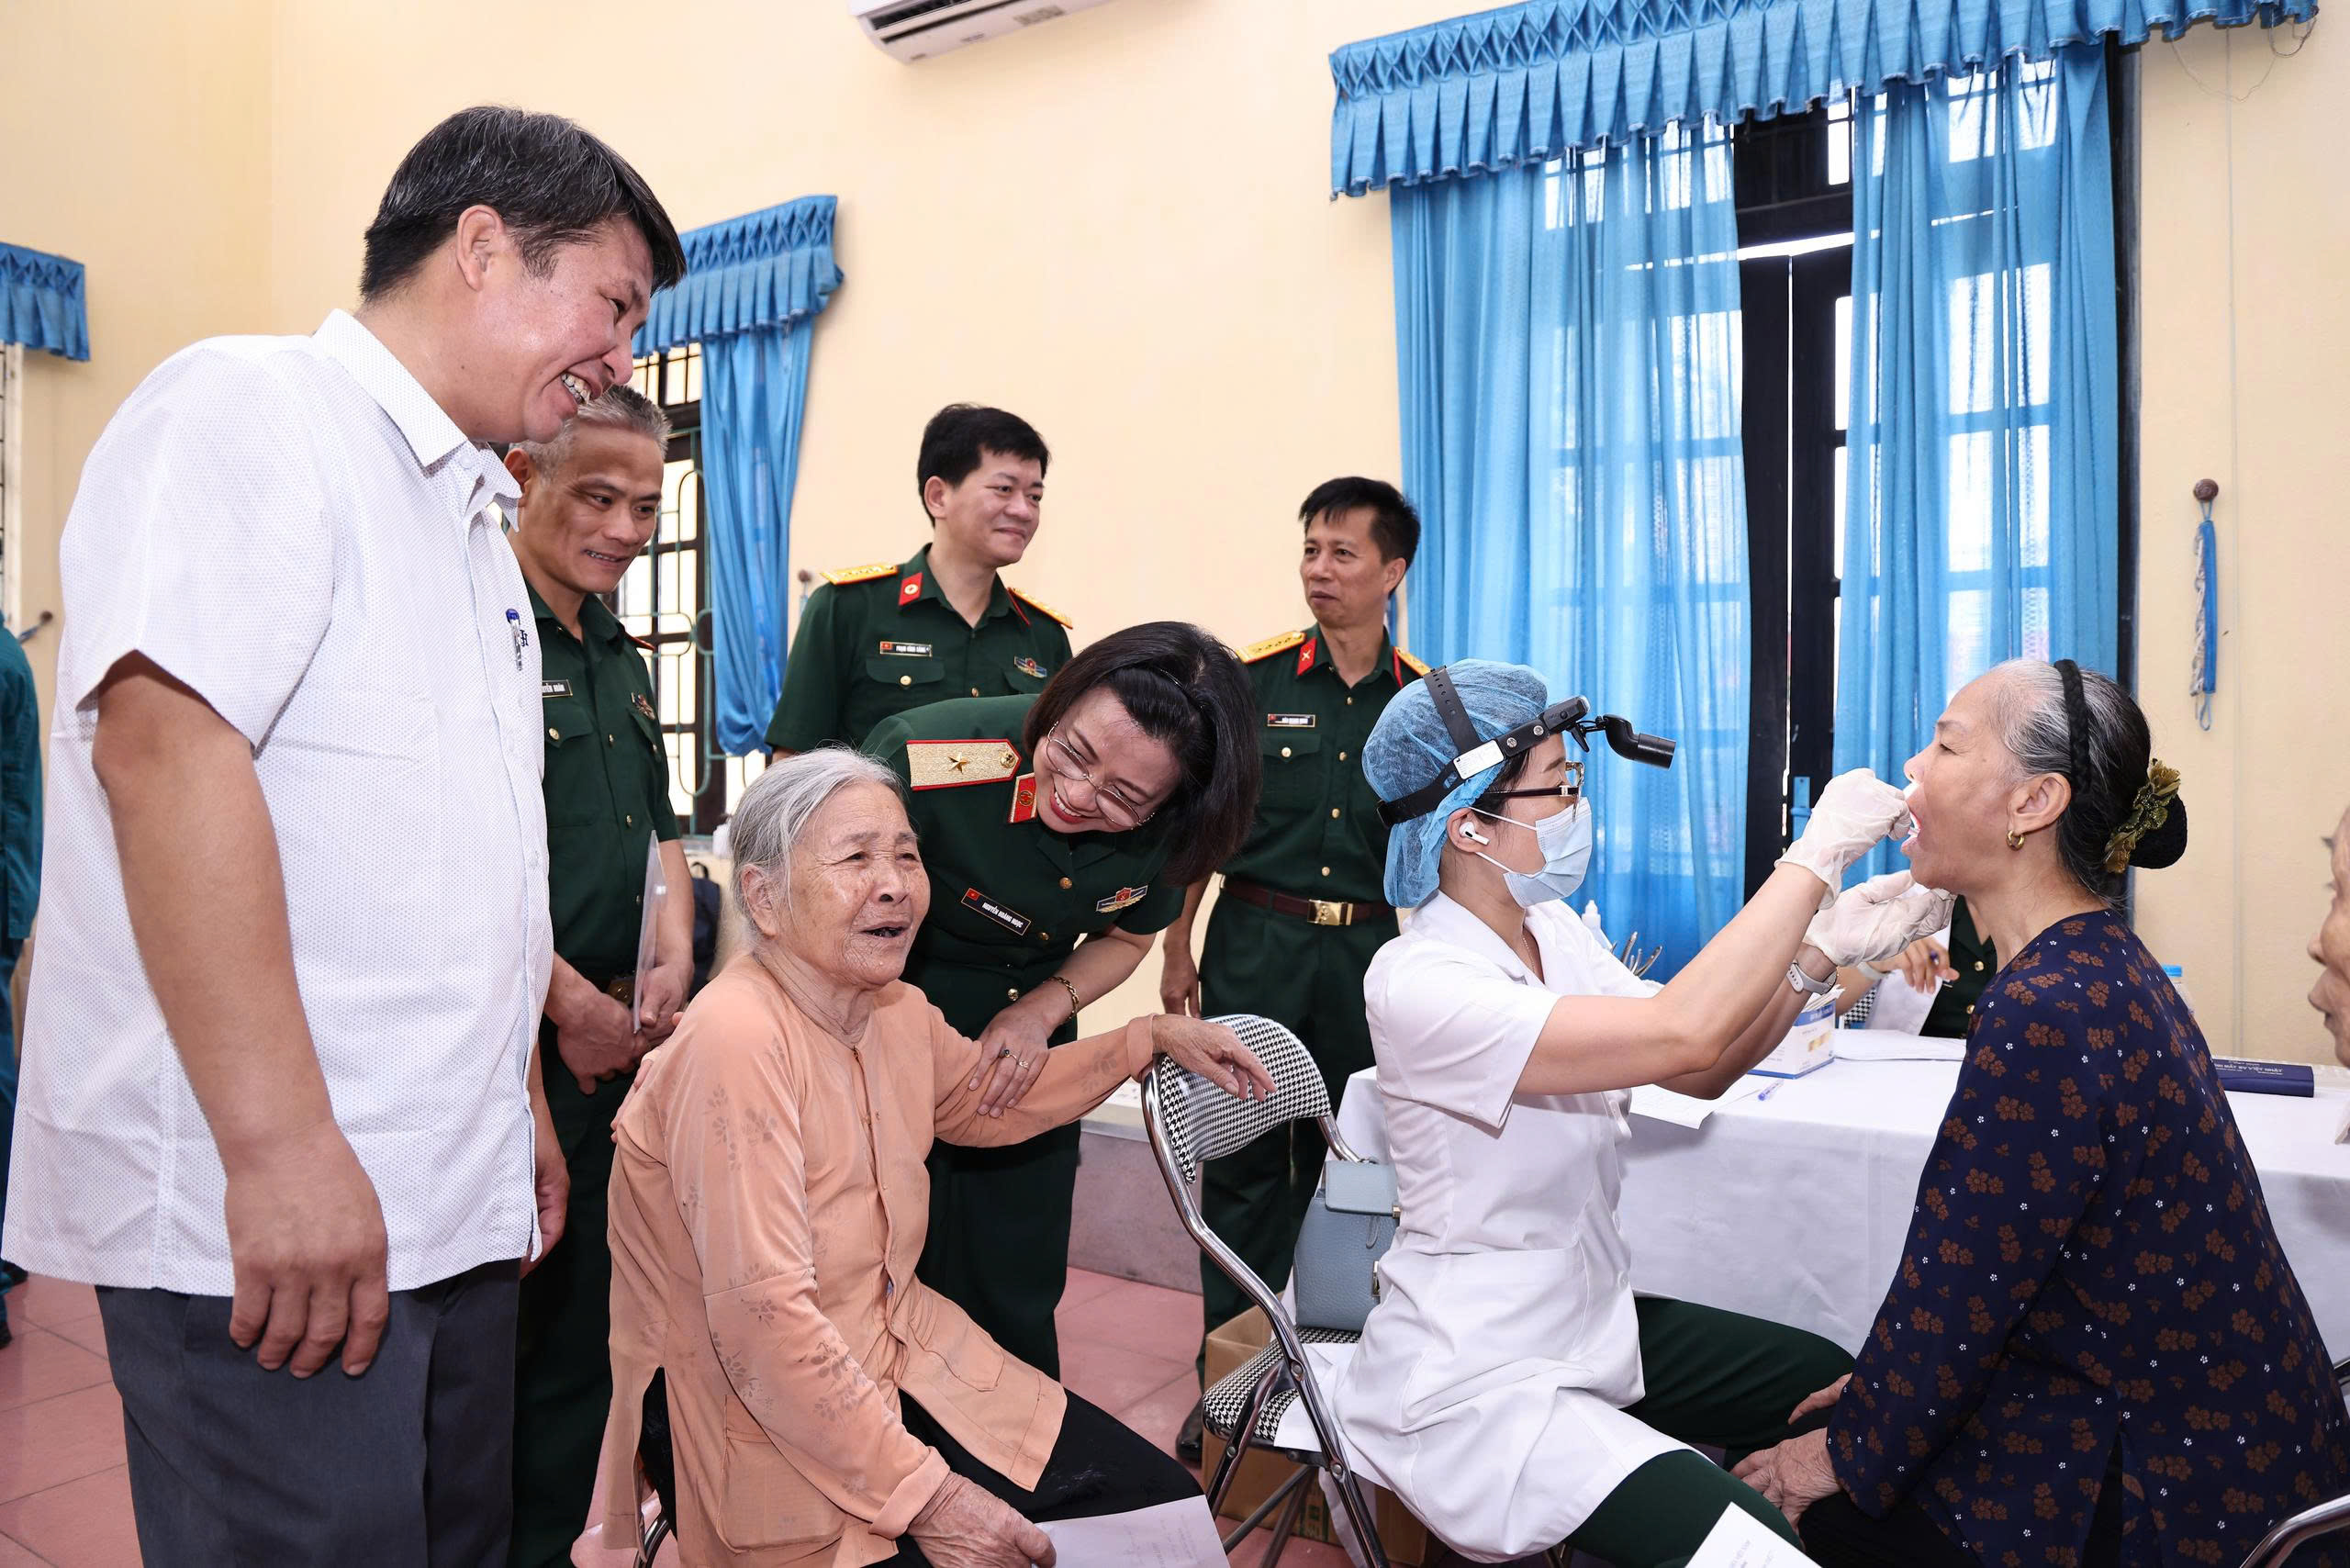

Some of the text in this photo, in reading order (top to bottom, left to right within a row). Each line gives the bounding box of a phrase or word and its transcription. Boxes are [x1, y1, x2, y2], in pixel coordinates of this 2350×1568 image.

[982, 902, 1024, 928] NGUYỄN HOÀNG NGỌC
